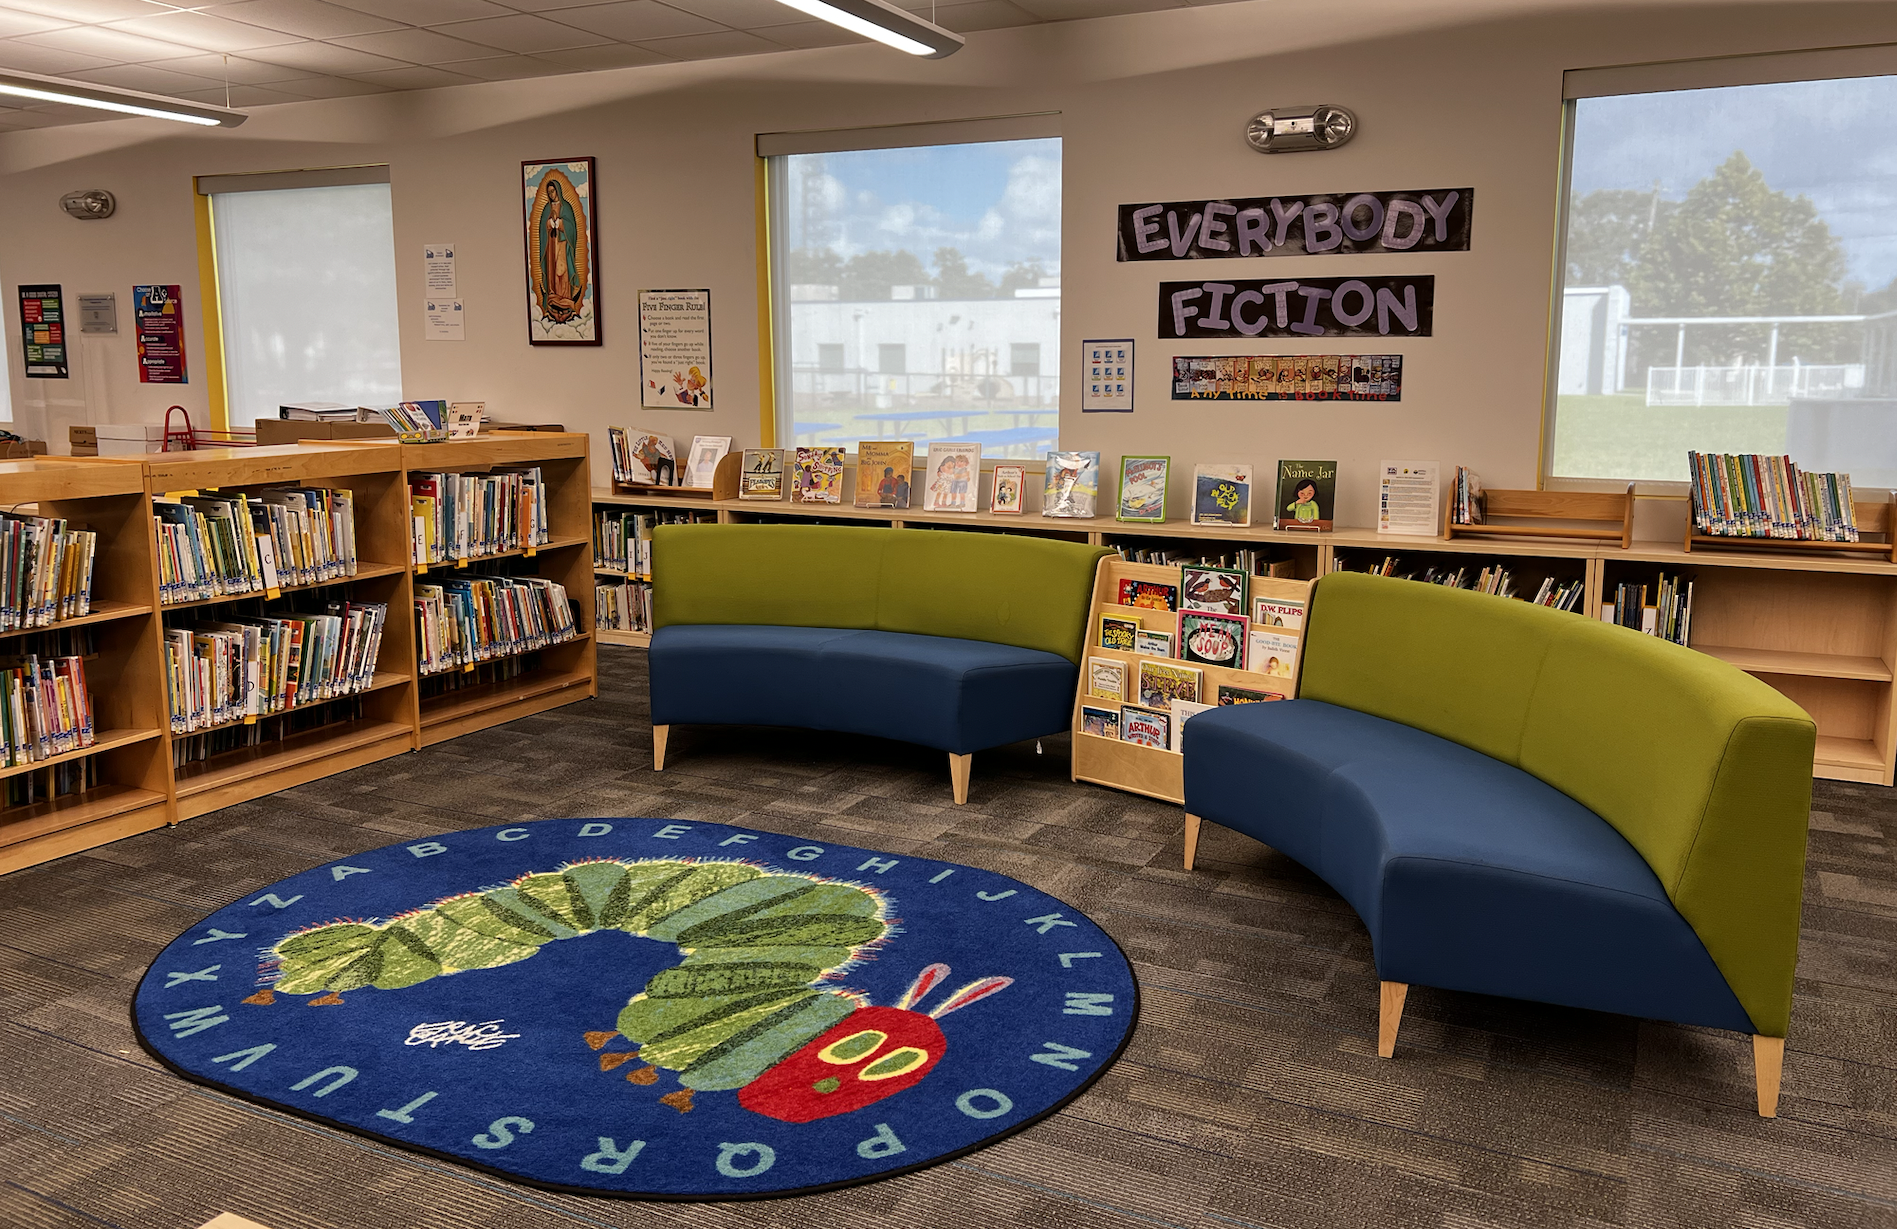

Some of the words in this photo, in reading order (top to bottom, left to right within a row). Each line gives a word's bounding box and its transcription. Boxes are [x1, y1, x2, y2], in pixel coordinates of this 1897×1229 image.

[1132, 191, 1459, 257] EVERYBODY
[659, 302, 684, 311] FINGER
[1171, 280, 1418, 336] FICTION
[1226, 390, 1268, 400] Time
[1347, 390, 1387, 400] Time
[1129, 472, 1147, 485] POOL
[1282, 465, 1314, 480] Name
[1316, 466, 1334, 480] Jar
[418, 535, 423, 544] E
[265, 554, 271, 564] C
[644, 552, 648, 560] J
[1137, 584, 1169, 596] ARTHUR
[1261, 604, 1276, 613] D.W.
[1278, 607, 1303, 617] FLIPS
[1111, 629, 1134, 640] SPOOKY
[1199, 622, 1232, 642] MEAN
[1104, 637, 1117, 645] OLD
[1196, 637, 1228, 657] SOUP
[1142, 664, 1154, 672] Our
[247, 681, 254, 692] D
[1142, 672, 1195, 698] STEVE
[1129, 722, 1160, 739] ARTHUR
[496, 828, 530, 841] C
[578, 823, 612, 836] D
[652, 824, 692, 839] E
[718, 834, 758, 846] F
[407, 842, 447, 858] B
[787, 846, 824, 860] G
[856, 857, 899, 874] H
[331, 866, 372, 881] A
[929, 869, 955, 883] I
[248, 893, 304, 908] Z
[977, 890, 1018, 901] J
[1024, 913, 1077, 934] K
[193, 929, 247, 945] Y
[1058, 952, 1102, 967] L
[164, 964, 221, 988] X
[1063, 992, 1114, 1016] M
[164, 1005, 229, 1038] W
[211, 1043, 277, 1071] V
[1030, 1042, 1092, 1071] N
[289, 1066, 359, 1097] U
[376, 1091, 438, 1123] T
[956, 1089, 1013, 1119] O
[472, 1116, 534, 1149] S
[857, 1123, 906, 1158] P
[580, 1137, 646, 1174] R
[716, 1142, 776, 1177] Q
